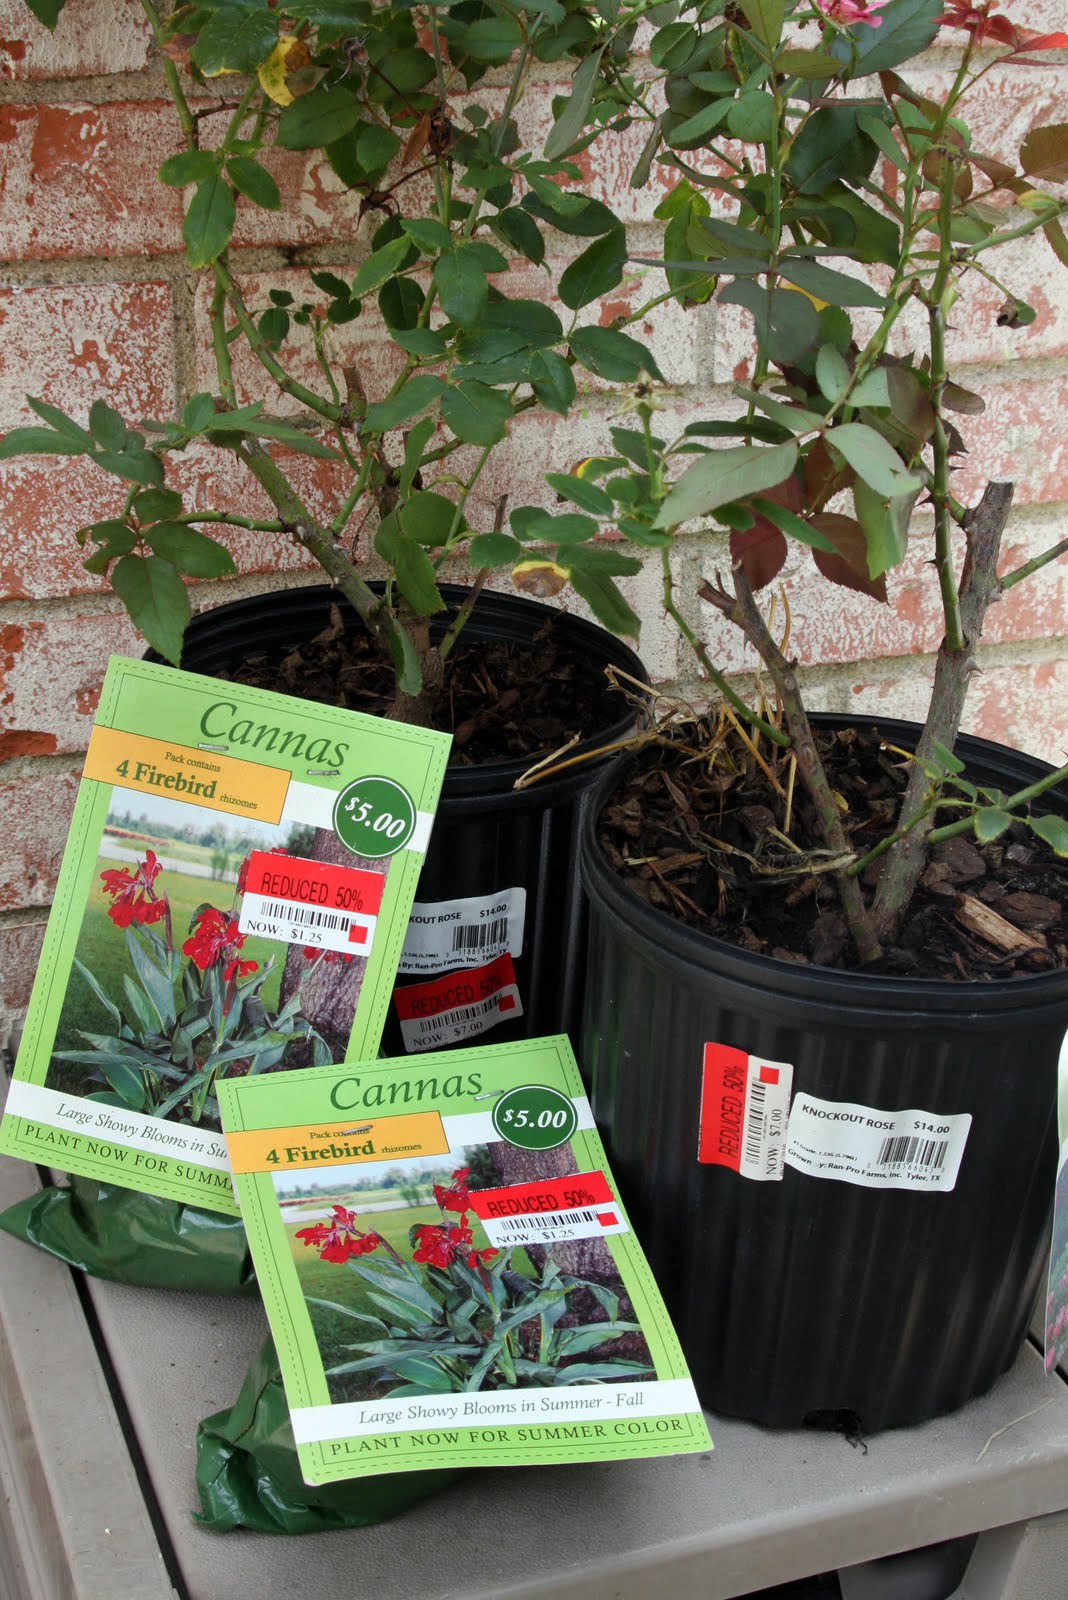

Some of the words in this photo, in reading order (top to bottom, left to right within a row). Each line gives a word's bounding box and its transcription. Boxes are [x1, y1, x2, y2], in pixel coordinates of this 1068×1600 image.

[200, 701, 350, 768] Cannas
[165, 751, 186, 765] Pack
[187, 756, 221, 773] contains
[115, 760, 129, 779] 4
[132, 761, 218, 799] Firebird
[219, 793, 258, 810] rhizomes
[344, 796, 406, 840] $5.00
[260, 872, 329, 904] REDUCED
[335, 886, 364, 911] 50%
[408, 915, 436, 925] KOUT
[438, 912, 462, 923] ROSE
[480, 904, 507, 918] $14.00
[247, 919, 283, 936] NOW:
[290, 928, 323, 944] $1.25
[411, 984, 475, 1017] REDUCED
[413, 1034, 448, 1047] NOW:
[454, 1021, 483, 1037] $7.00
[330, 1072, 483, 1112] Cannas
[723, 1065, 745, 1093] 50%
[56, 1103, 93, 1125] Large
[95, 1113, 139, 1137] Showy
[140, 1125, 188, 1148] Blooms
[190, 1138, 204, 1152] in
[206, 1142, 228, 1159] Su
[504, 1109, 567, 1128] $5.00
[718, 1096, 742, 1159] REDUCED
[769, 1108, 783, 1137] $7.00
[802, 1104, 865, 1124] KNOCKOUT
[866, 1119, 896, 1131] ROSE
[914, 1121, 950, 1134] $14.00
[309, 1131, 331, 1140] Pack
[25, 1124, 82, 1150] PLANT
[86, 1141, 129, 1163] NOW
[134, 1154, 168, 1174] FOR
[174, 1164, 233, 1191] SUMM
[265, 1150, 280, 1165] 4
[287, 1140, 376, 1163] Firebird
[381, 1143, 422, 1153] rhizomes
[766, 1143, 779, 1175] NOW:
[788, 1148, 812, 1165] Grown
[828, 1162, 860, 1174] Ran-Pro
[861, 1169, 887, 1178] Farms,
[907, 1172, 928, 1181] Tyler,
[487, 1194, 559, 1217] REDUCED
[564, 1188, 596, 1206] 50%
[496, 1233, 535, 1244] NOW:
[542, 1229, 575, 1240] $1.25
[359, 1411, 402, 1425] Large
[407, 1405, 458, 1420] Showy
[463, 1401, 517, 1415] Blooms
[521, 1400, 536, 1412] in
[540, 1397, 603, 1411] Summer
[616, 1392, 644, 1407] Fall
[331, 1436, 401, 1456] PLANT
[411, 1432, 460, 1446] NOW
[469, 1430, 510, 1443] FOR
[518, 1425, 607, 1441] SUMMER
[614, 1419, 684, 1434] COLOR
